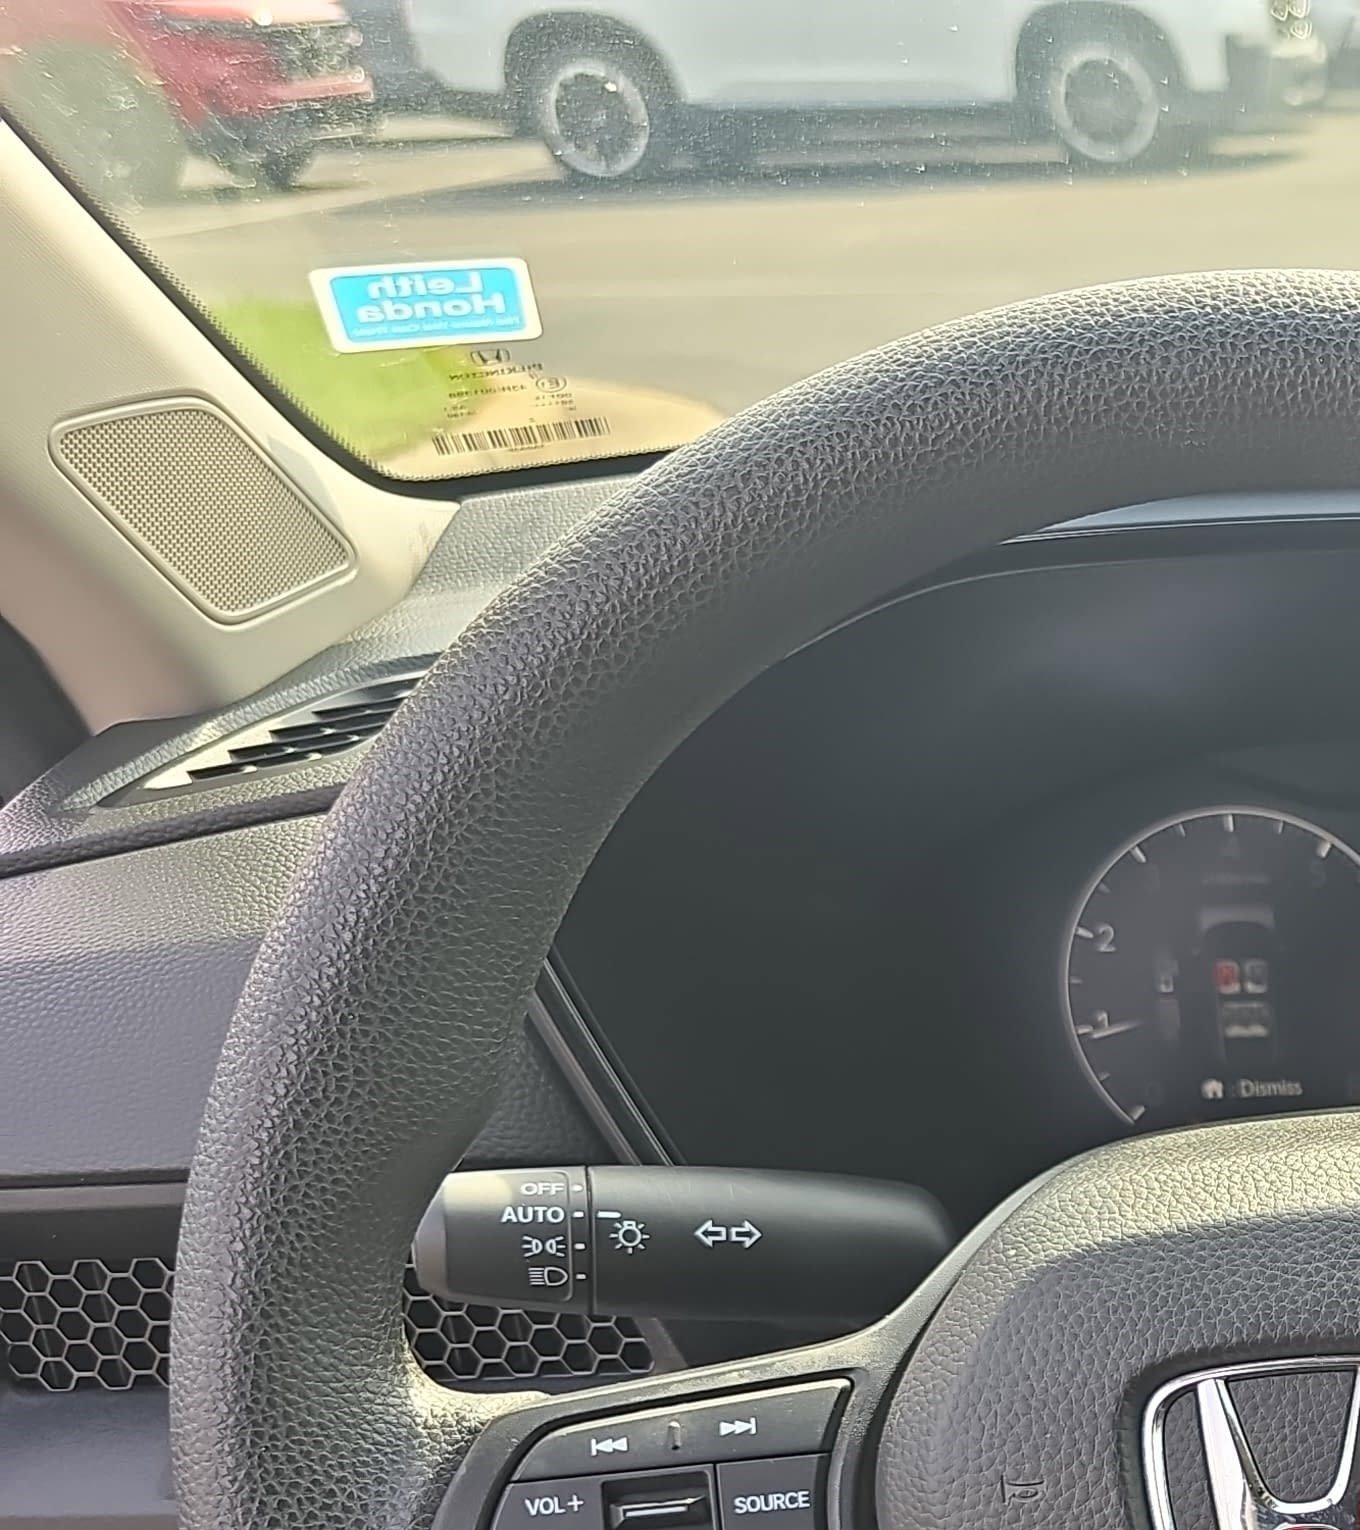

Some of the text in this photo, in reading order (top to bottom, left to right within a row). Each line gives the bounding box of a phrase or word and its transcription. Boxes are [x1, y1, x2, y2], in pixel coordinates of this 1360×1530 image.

[1095, 928, 1116, 952] 2
[1240, 1078, 1302, 1099] Dismiss
[520, 1182, 565, 1195] OFF
[500, 1206, 566, 1224] AUTO
[734, 1490, 810, 1515] SOURCE
